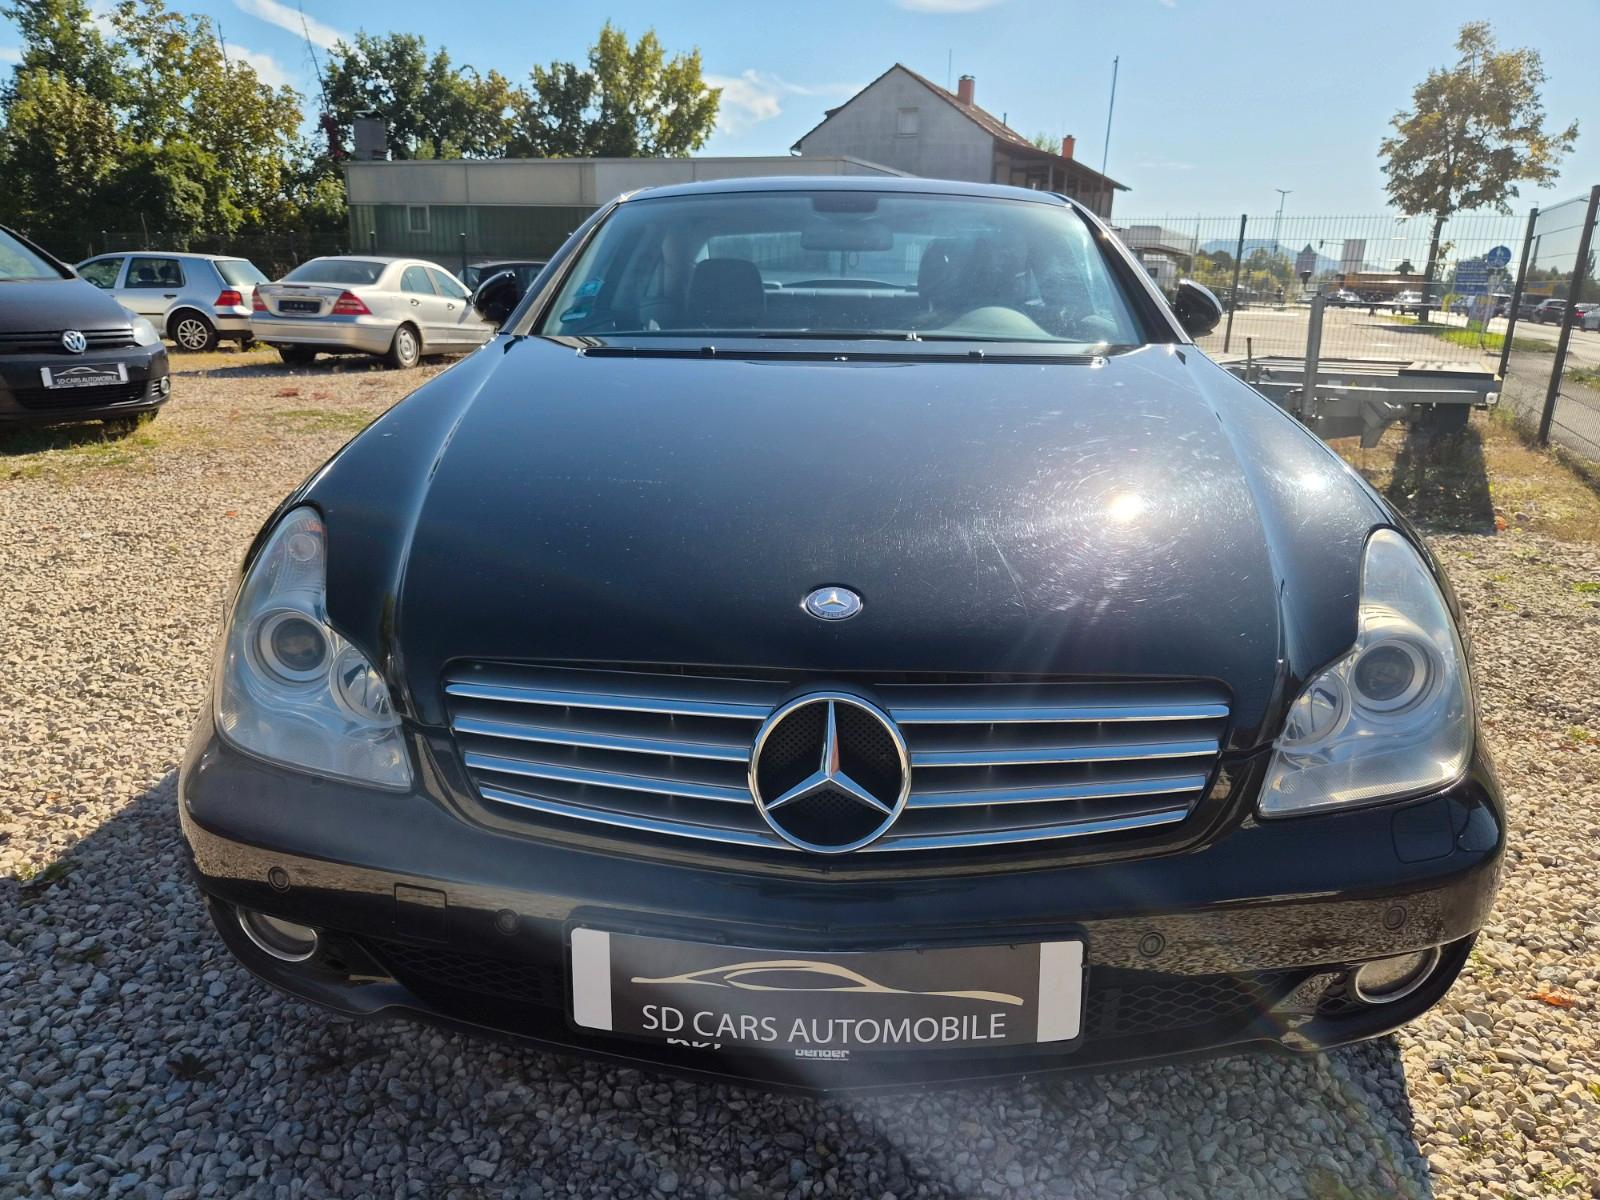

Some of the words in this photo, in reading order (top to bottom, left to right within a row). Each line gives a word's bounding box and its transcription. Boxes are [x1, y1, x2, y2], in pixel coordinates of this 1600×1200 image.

[642, 1004, 684, 1032] SD
[693, 1011, 778, 1042] CARS
[787, 1012, 1006, 1044] AUTOMOBILE
